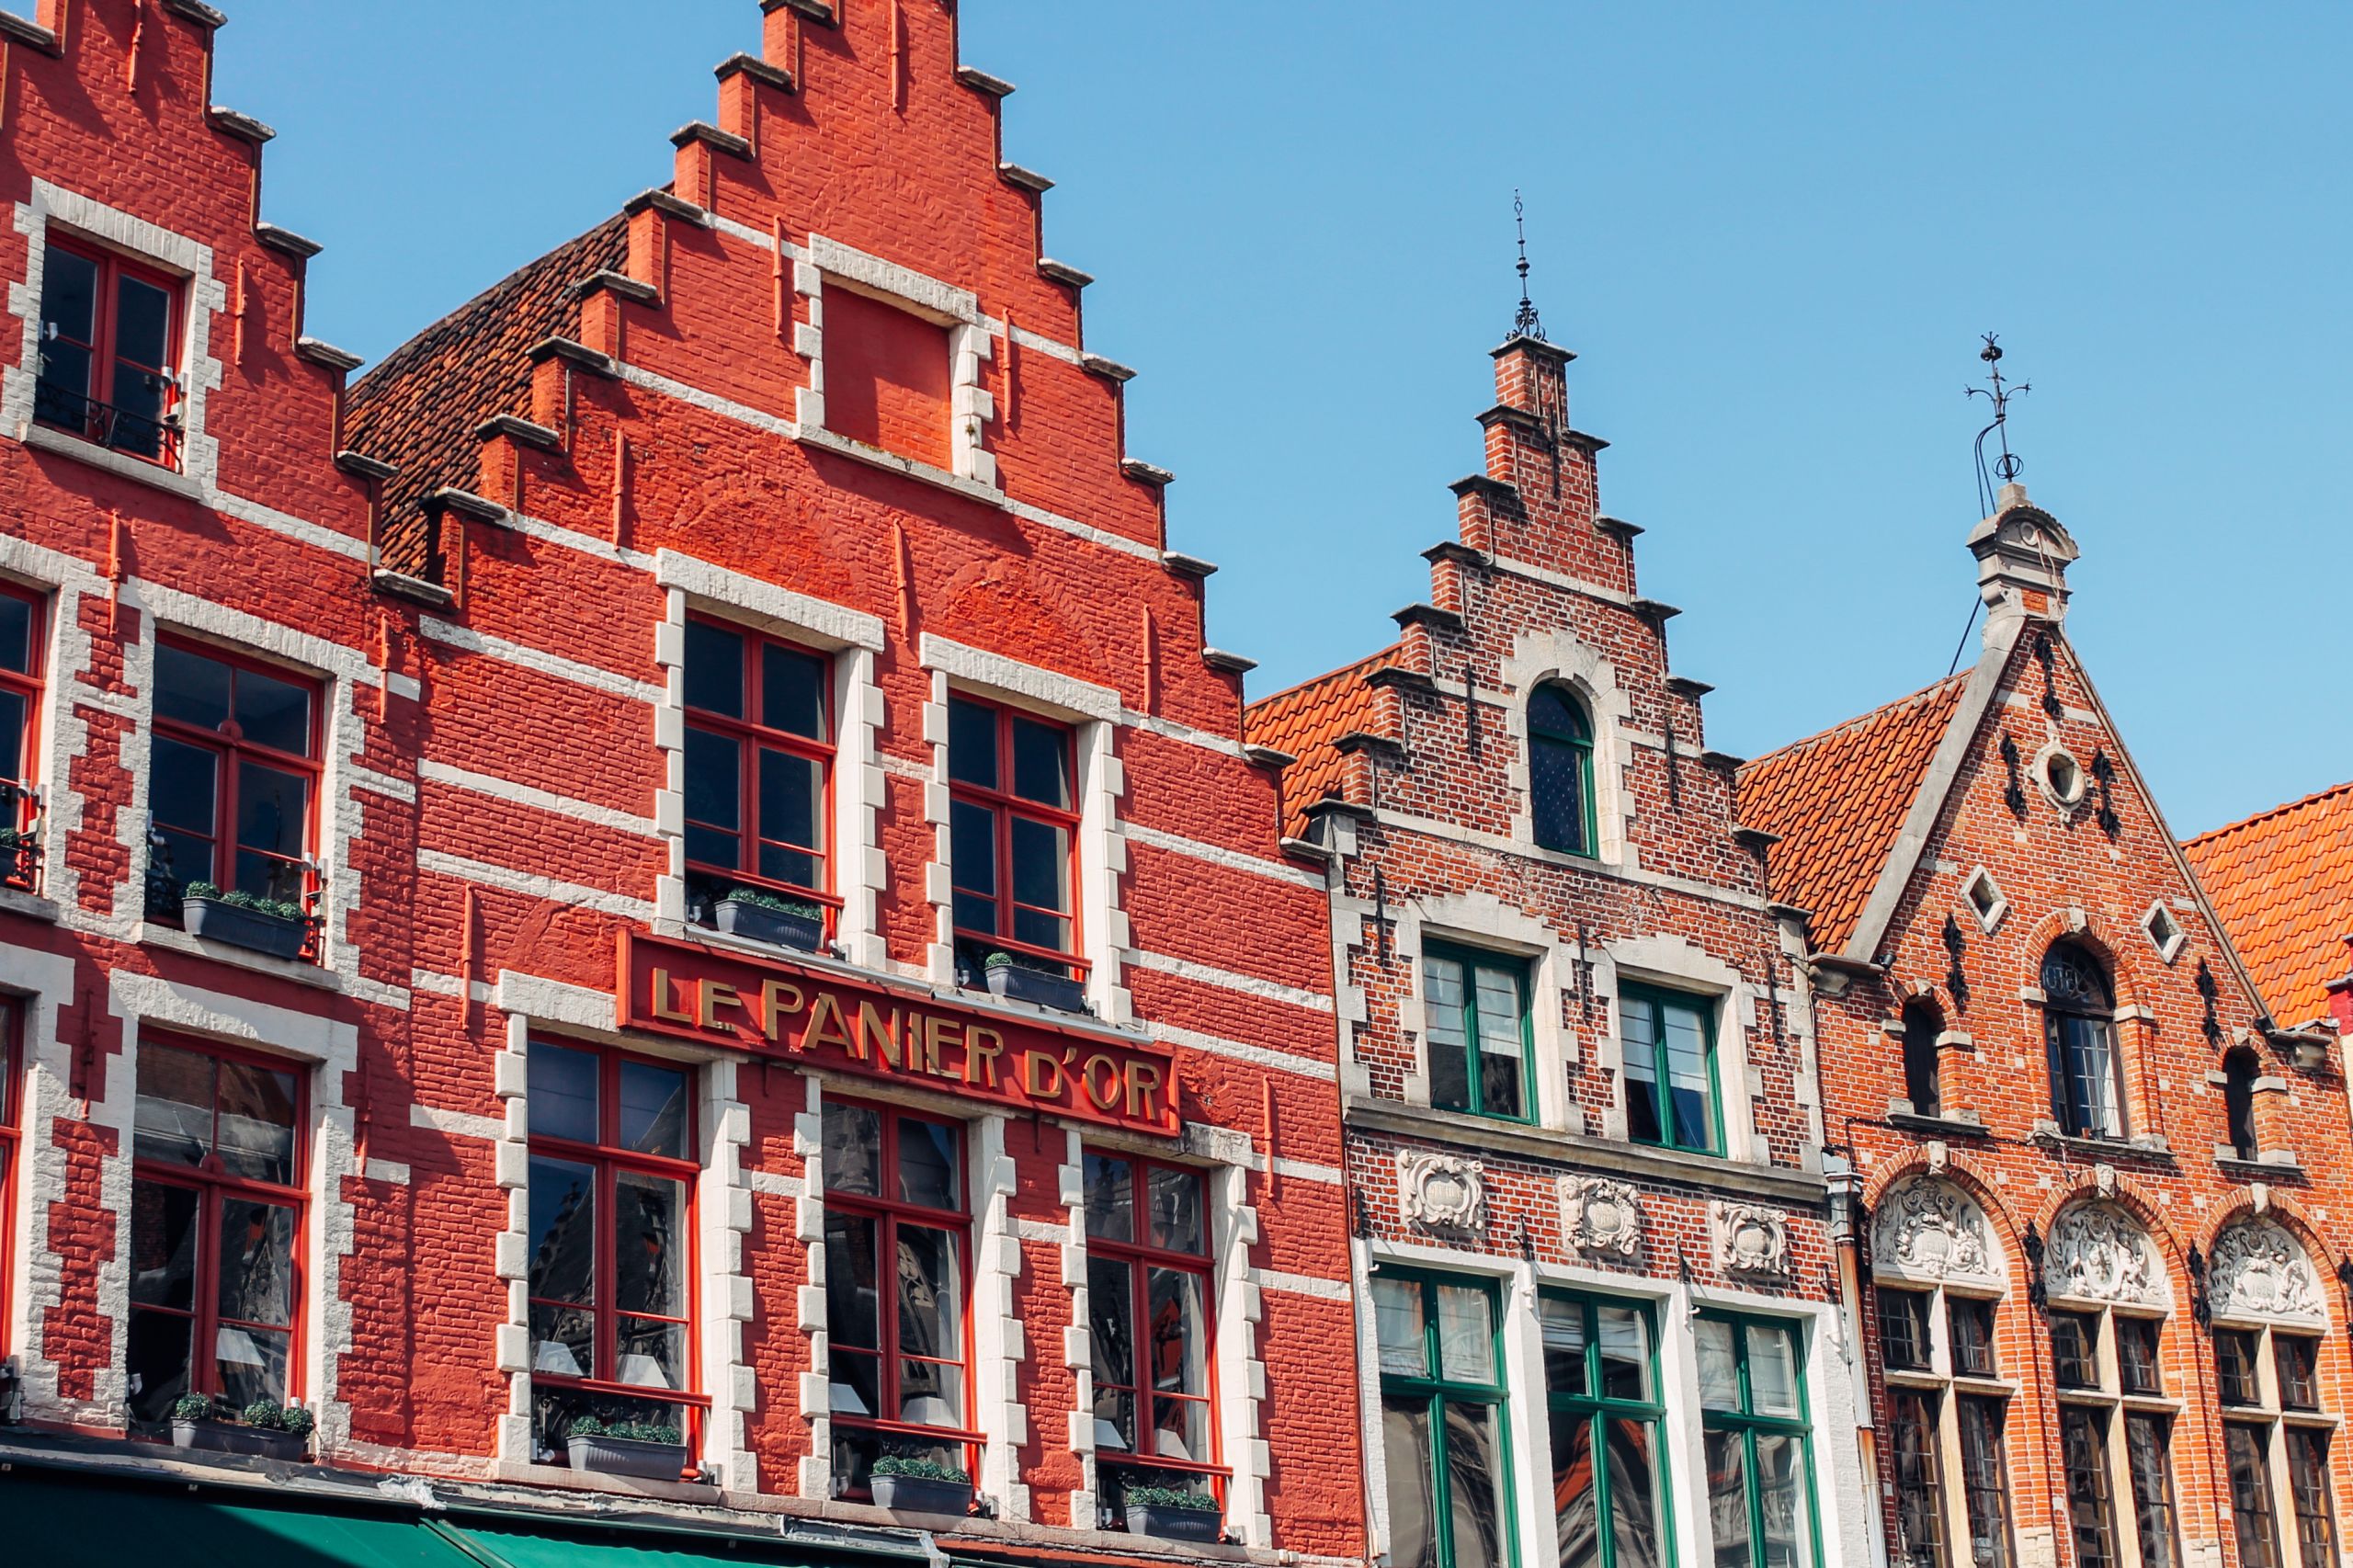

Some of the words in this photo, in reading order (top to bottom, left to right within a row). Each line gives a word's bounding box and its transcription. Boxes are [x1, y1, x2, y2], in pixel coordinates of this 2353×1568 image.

[651, 968, 742, 1032] LE
[761, 978, 1004, 1086] PANIER
[1024, 1046, 1161, 1120] D'OR
